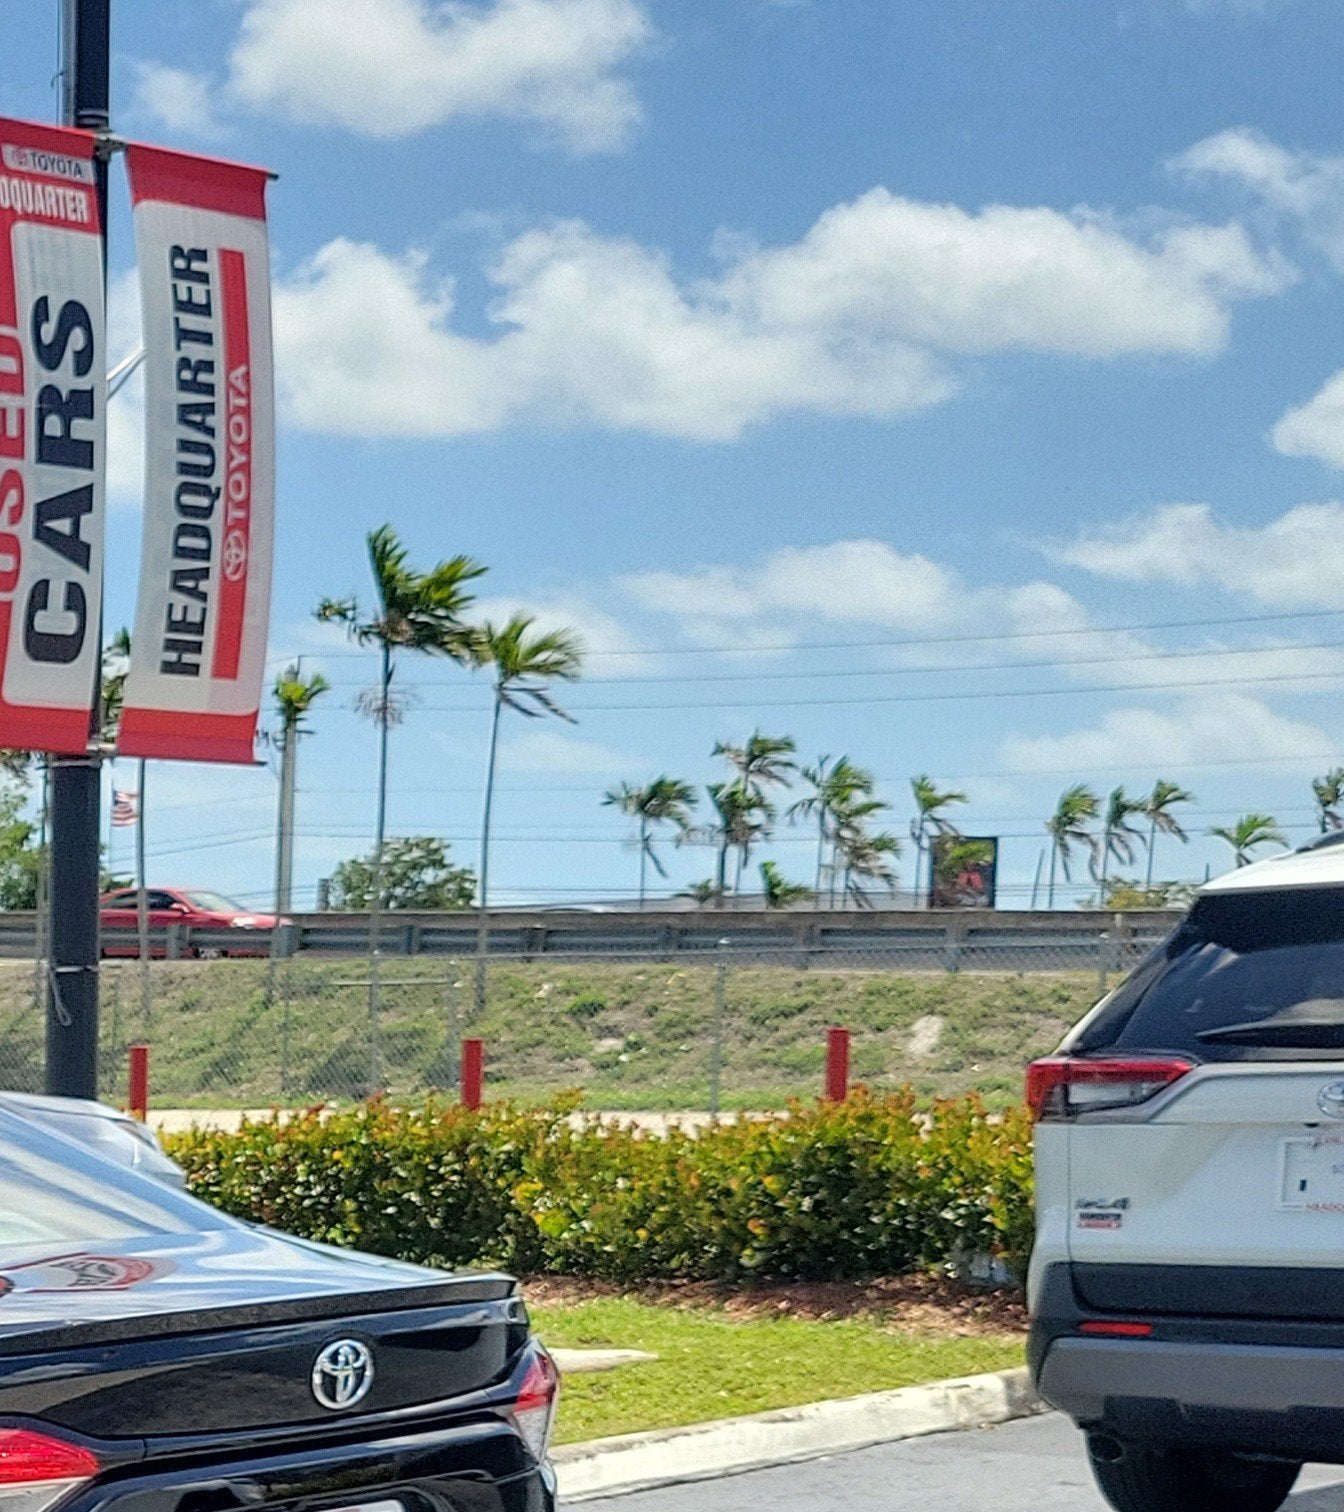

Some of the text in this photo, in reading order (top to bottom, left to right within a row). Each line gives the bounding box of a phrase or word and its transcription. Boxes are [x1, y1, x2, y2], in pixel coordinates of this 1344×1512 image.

[30, 150, 83, 178] TOYOTA
[23, 295, 95, 665] CARS
[159, 243, 221, 678] HEADQUARTER
[223, 364, 251, 522] TOYOTA
